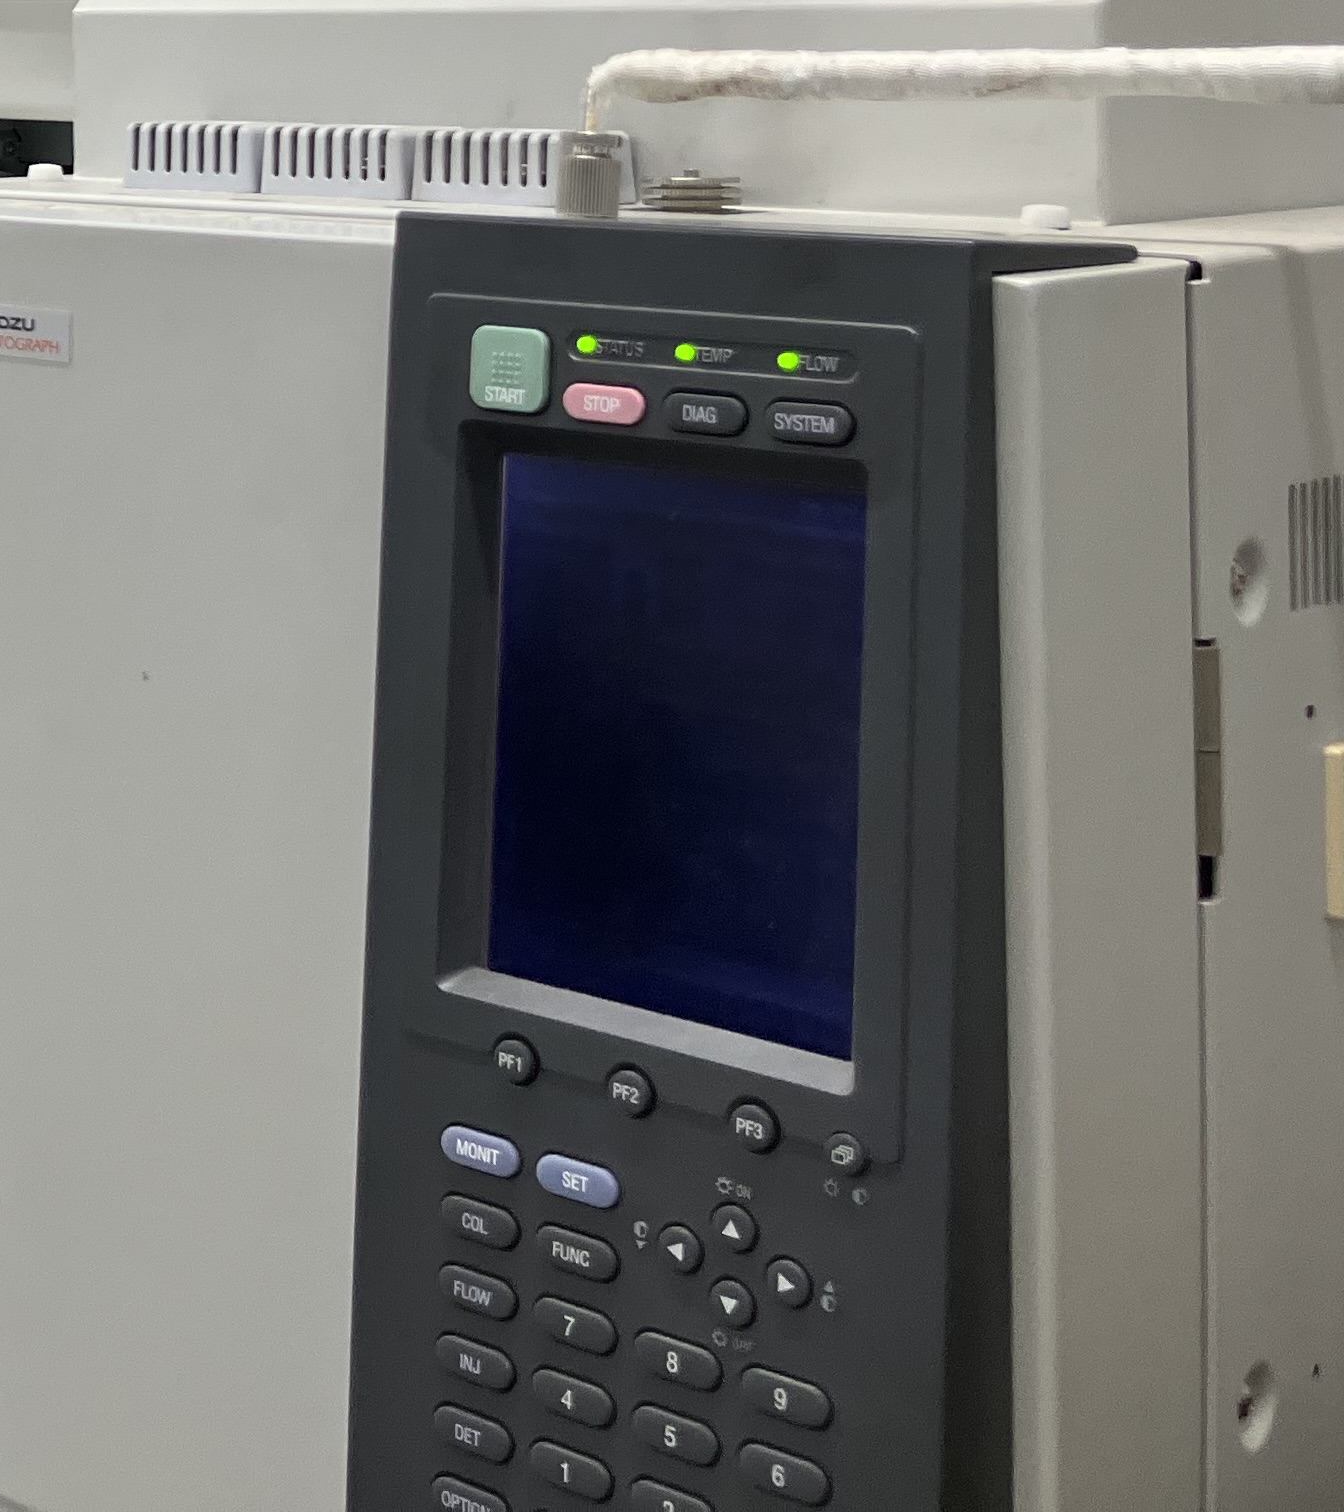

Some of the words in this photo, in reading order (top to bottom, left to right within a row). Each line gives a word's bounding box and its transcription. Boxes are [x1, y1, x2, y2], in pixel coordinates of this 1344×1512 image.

[484, 386, 526, 405] START
[583, 394, 620, 413] STOP
[682, 404, 717, 424] DIAG
[774, 412, 836, 434] SYSTEM
[498, 1050, 524, 1073] PF1
[612, 1082, 639, 1106] PF2
[735, 1117, 764, 1140] PF3
[456, 1138, 499, 1167] MONIT
[562, 1171, 589, 1194] SET
[462, 1212, 488, 1236] COL
[552, 1240, 590, 1268] FUNC
[453, 1279, 494, 1307] FLOW
[563, 1315, 576, 1337] 7
[459, 1353, 481, 1376] INJ
[666, 1351, 679, 1374] 8
[560, 1390, 573, 1409] 4
[773, 1388, 787, 1411] 9
[454, 1424, 481, 1447] DET
[663, 1427, 677, 1448] 5
[560, 1461, 570, 1484] 1
[770, 1464, 786, 1487] 6
